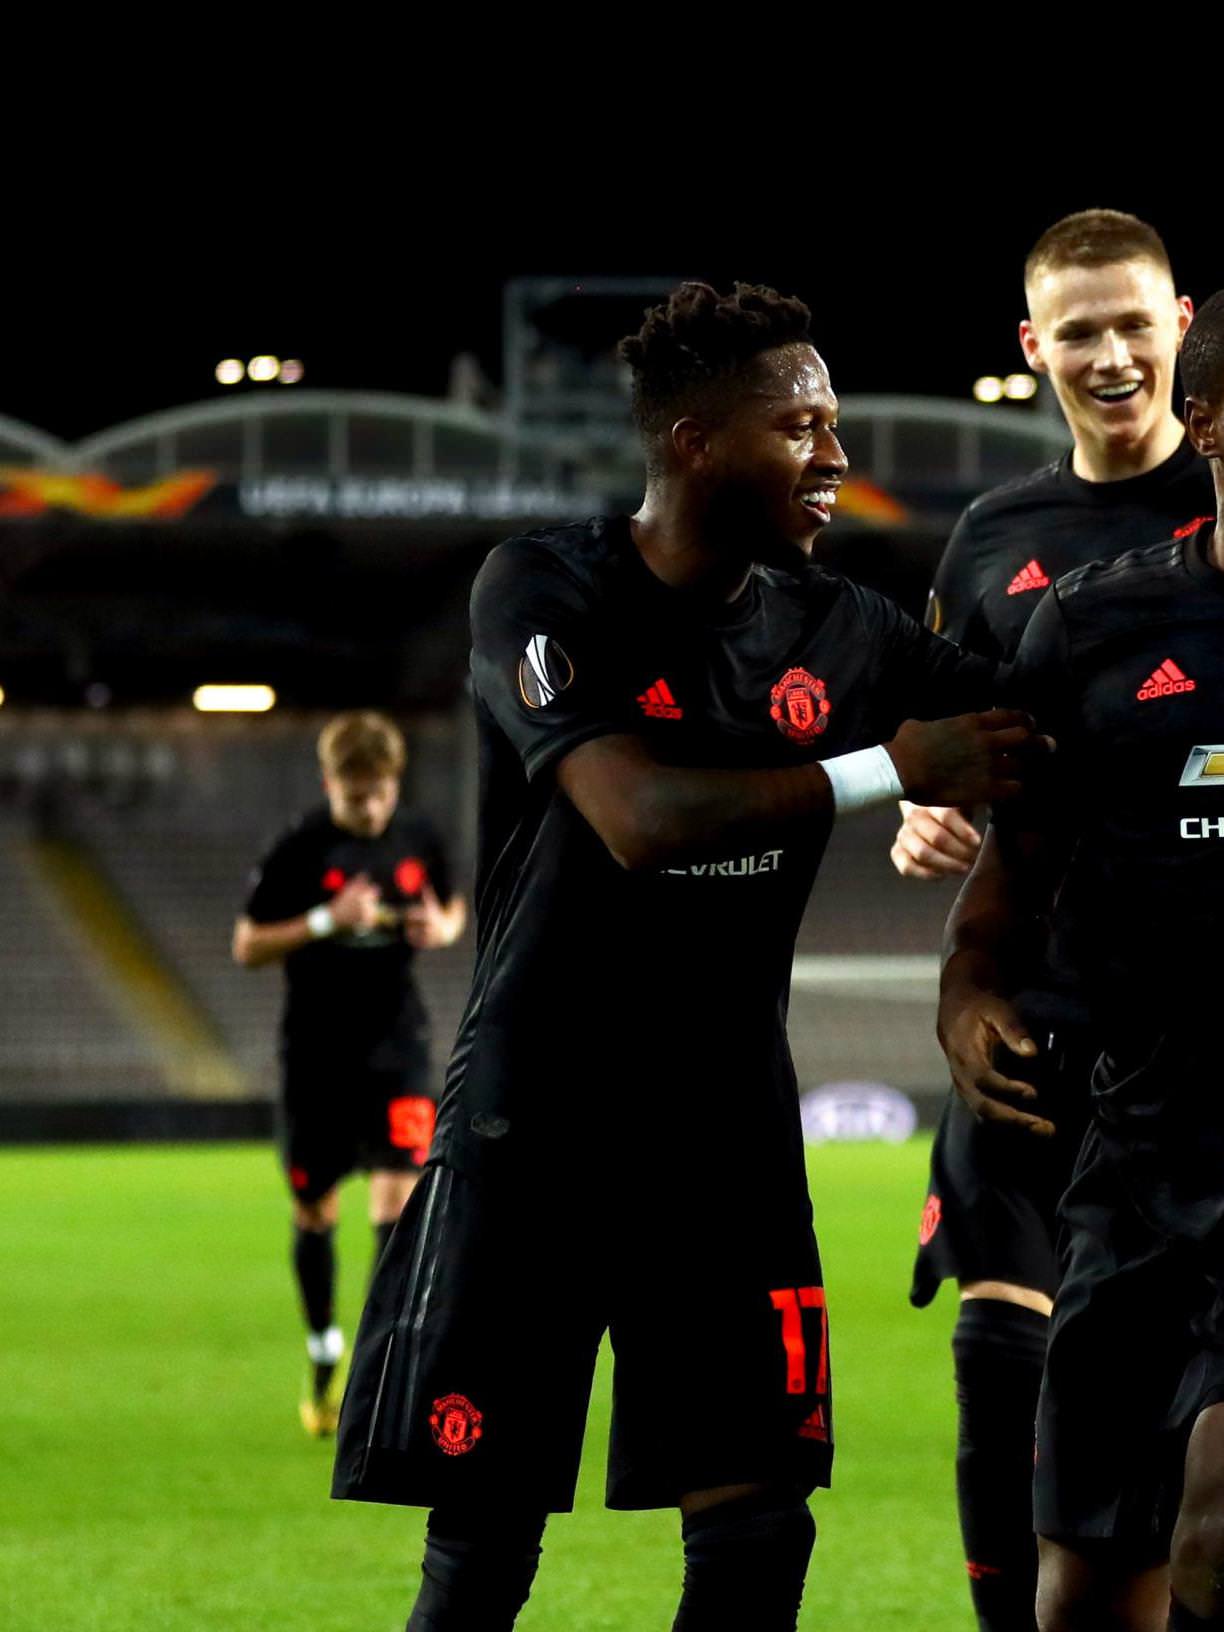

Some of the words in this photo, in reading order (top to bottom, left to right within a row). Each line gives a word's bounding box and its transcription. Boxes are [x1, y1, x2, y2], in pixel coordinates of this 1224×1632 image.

[1007, 576, 1050, 596] adidas
[1136, 679, 1196, 701] adidas
[660, 849, 784, 877] VROLET
[768, 1286, 828, 1395] 17
